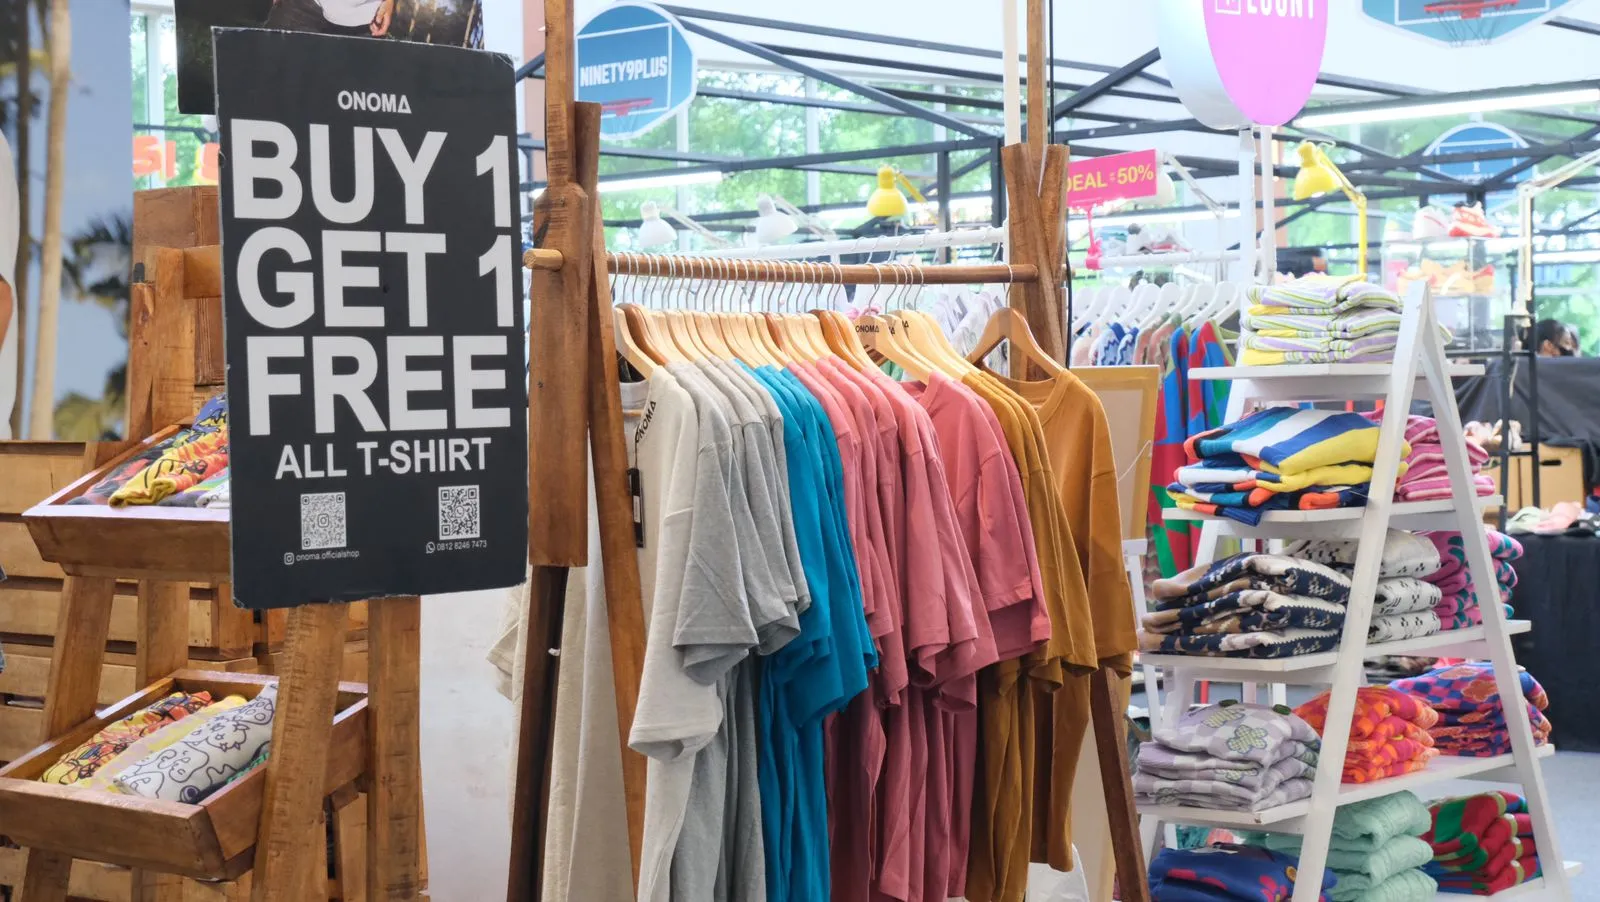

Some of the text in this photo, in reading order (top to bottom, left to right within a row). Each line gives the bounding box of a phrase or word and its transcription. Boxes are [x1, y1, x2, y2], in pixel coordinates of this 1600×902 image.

[579, 56, 668, 87] NINETY9PLUS
[337, 90, 412, 114] ONOMA
[230, 118, 512, 228] BUY 1
[1117, 163, 1154, 185] 50%
[236, 226, 514, 329] GET 1
[246, 335, 511, 436] FREE
[275, 437, 492, 480] ALL T-SHIRT
